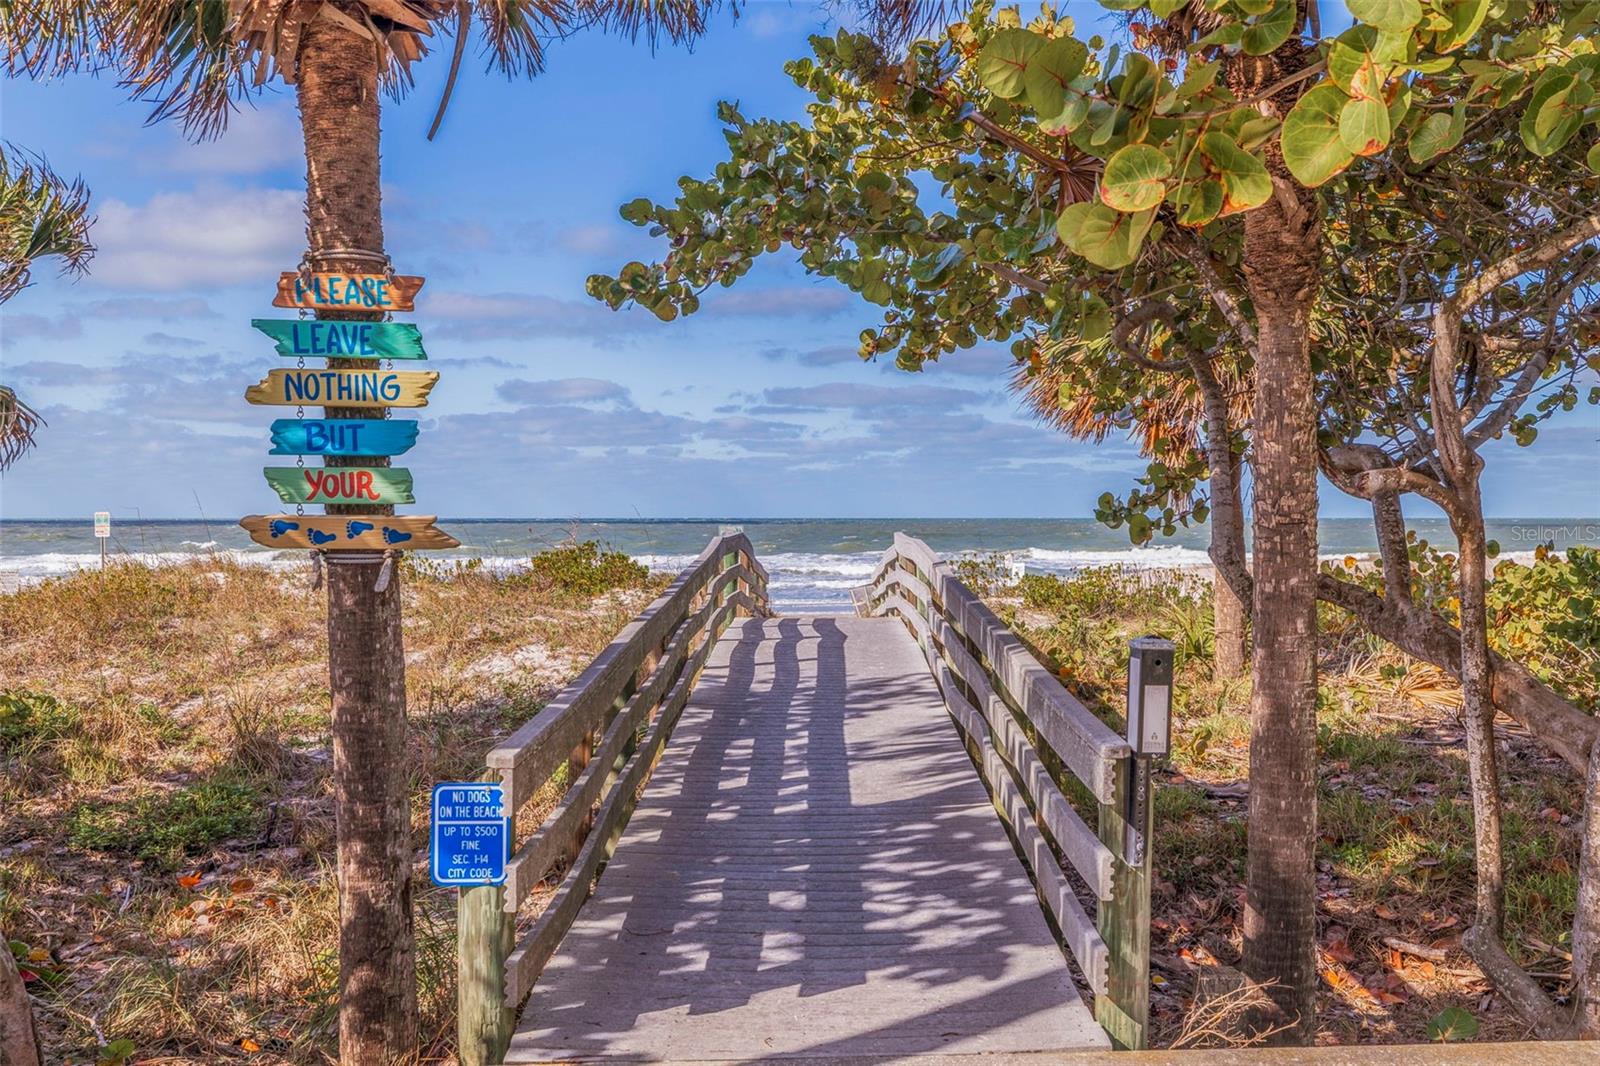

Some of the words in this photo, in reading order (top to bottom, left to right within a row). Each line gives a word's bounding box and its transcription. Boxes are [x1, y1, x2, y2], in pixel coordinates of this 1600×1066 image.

[294, 276, 392, 307] PLEASE
[292, 323, 376, 355] LEAVE
[284, 372, 401, 401] NOTHING
[302, 422, 365, 451] BUT
[304, 469, 381, 501] YOUR
[452, 791, 465, 803] NO
[467, 791, 491, 803] DOGS
[440, 806, 452, 818] ON
[455, 806, 471, 818] THE
[473, 806, 501, 818] BEACH
[443, 826, 456, 837] UP
[460, 826, 471, 837] TO
[474, 826, 498, 838] $500
[461, 840, 480, 850] FINE
[447, 868, 466, 878] CITY
[469, 868, 493, 878] CODE
